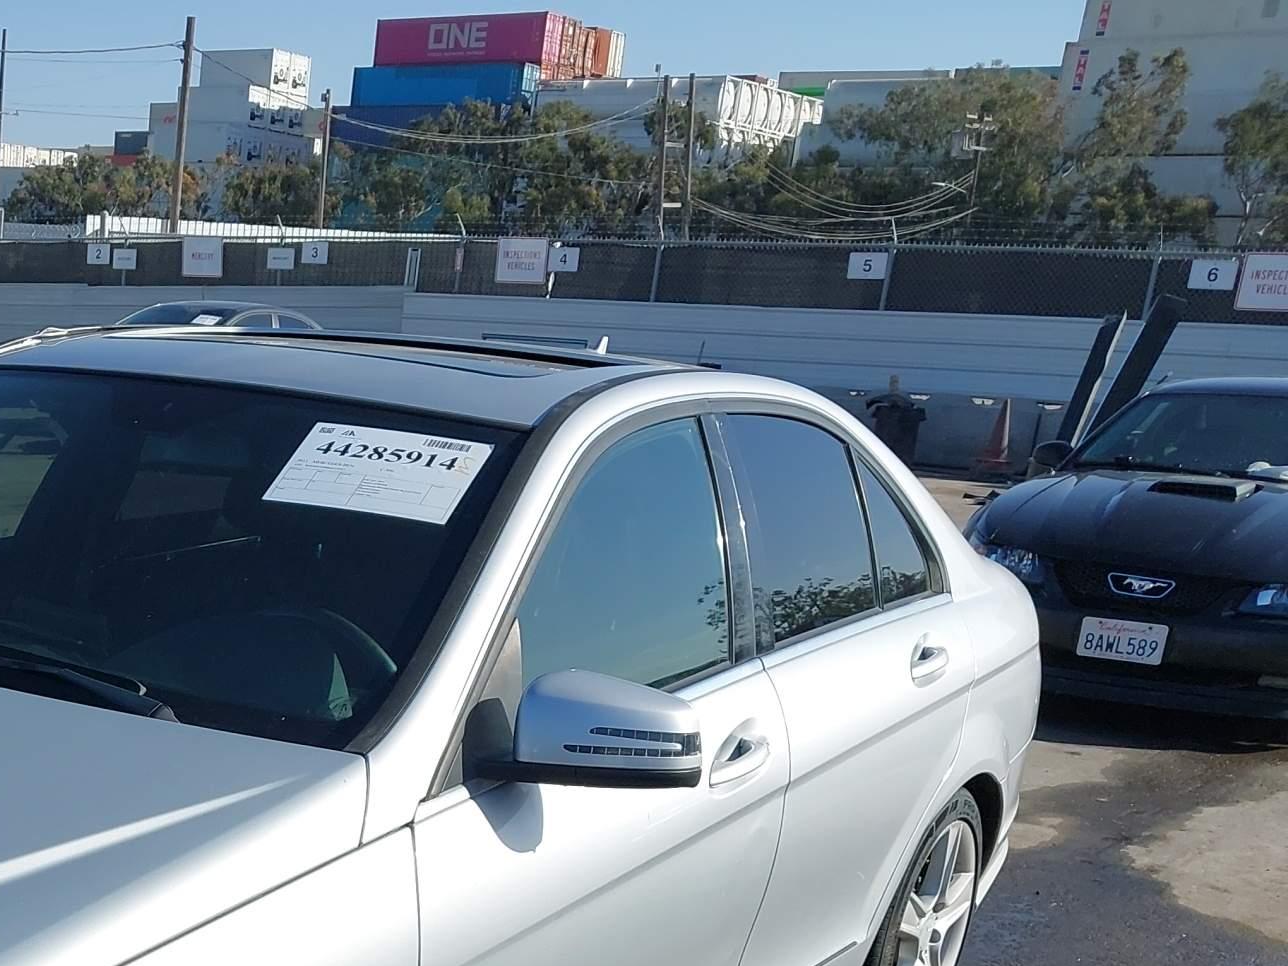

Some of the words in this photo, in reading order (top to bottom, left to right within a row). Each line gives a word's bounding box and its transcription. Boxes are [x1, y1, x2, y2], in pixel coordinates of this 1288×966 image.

[428, 22, 489, 49] ONE
[95, 248, 102, 259] 2
[311, 247, 319, 258] 3
[559, 253, 568, 265] 4
[863, 259, 872, 272] 5
[1207, 267, 1219, 282] 6
[316, 440, 459, 471] 44285914
[1084, 632, 1159, 658] 8AWL589
